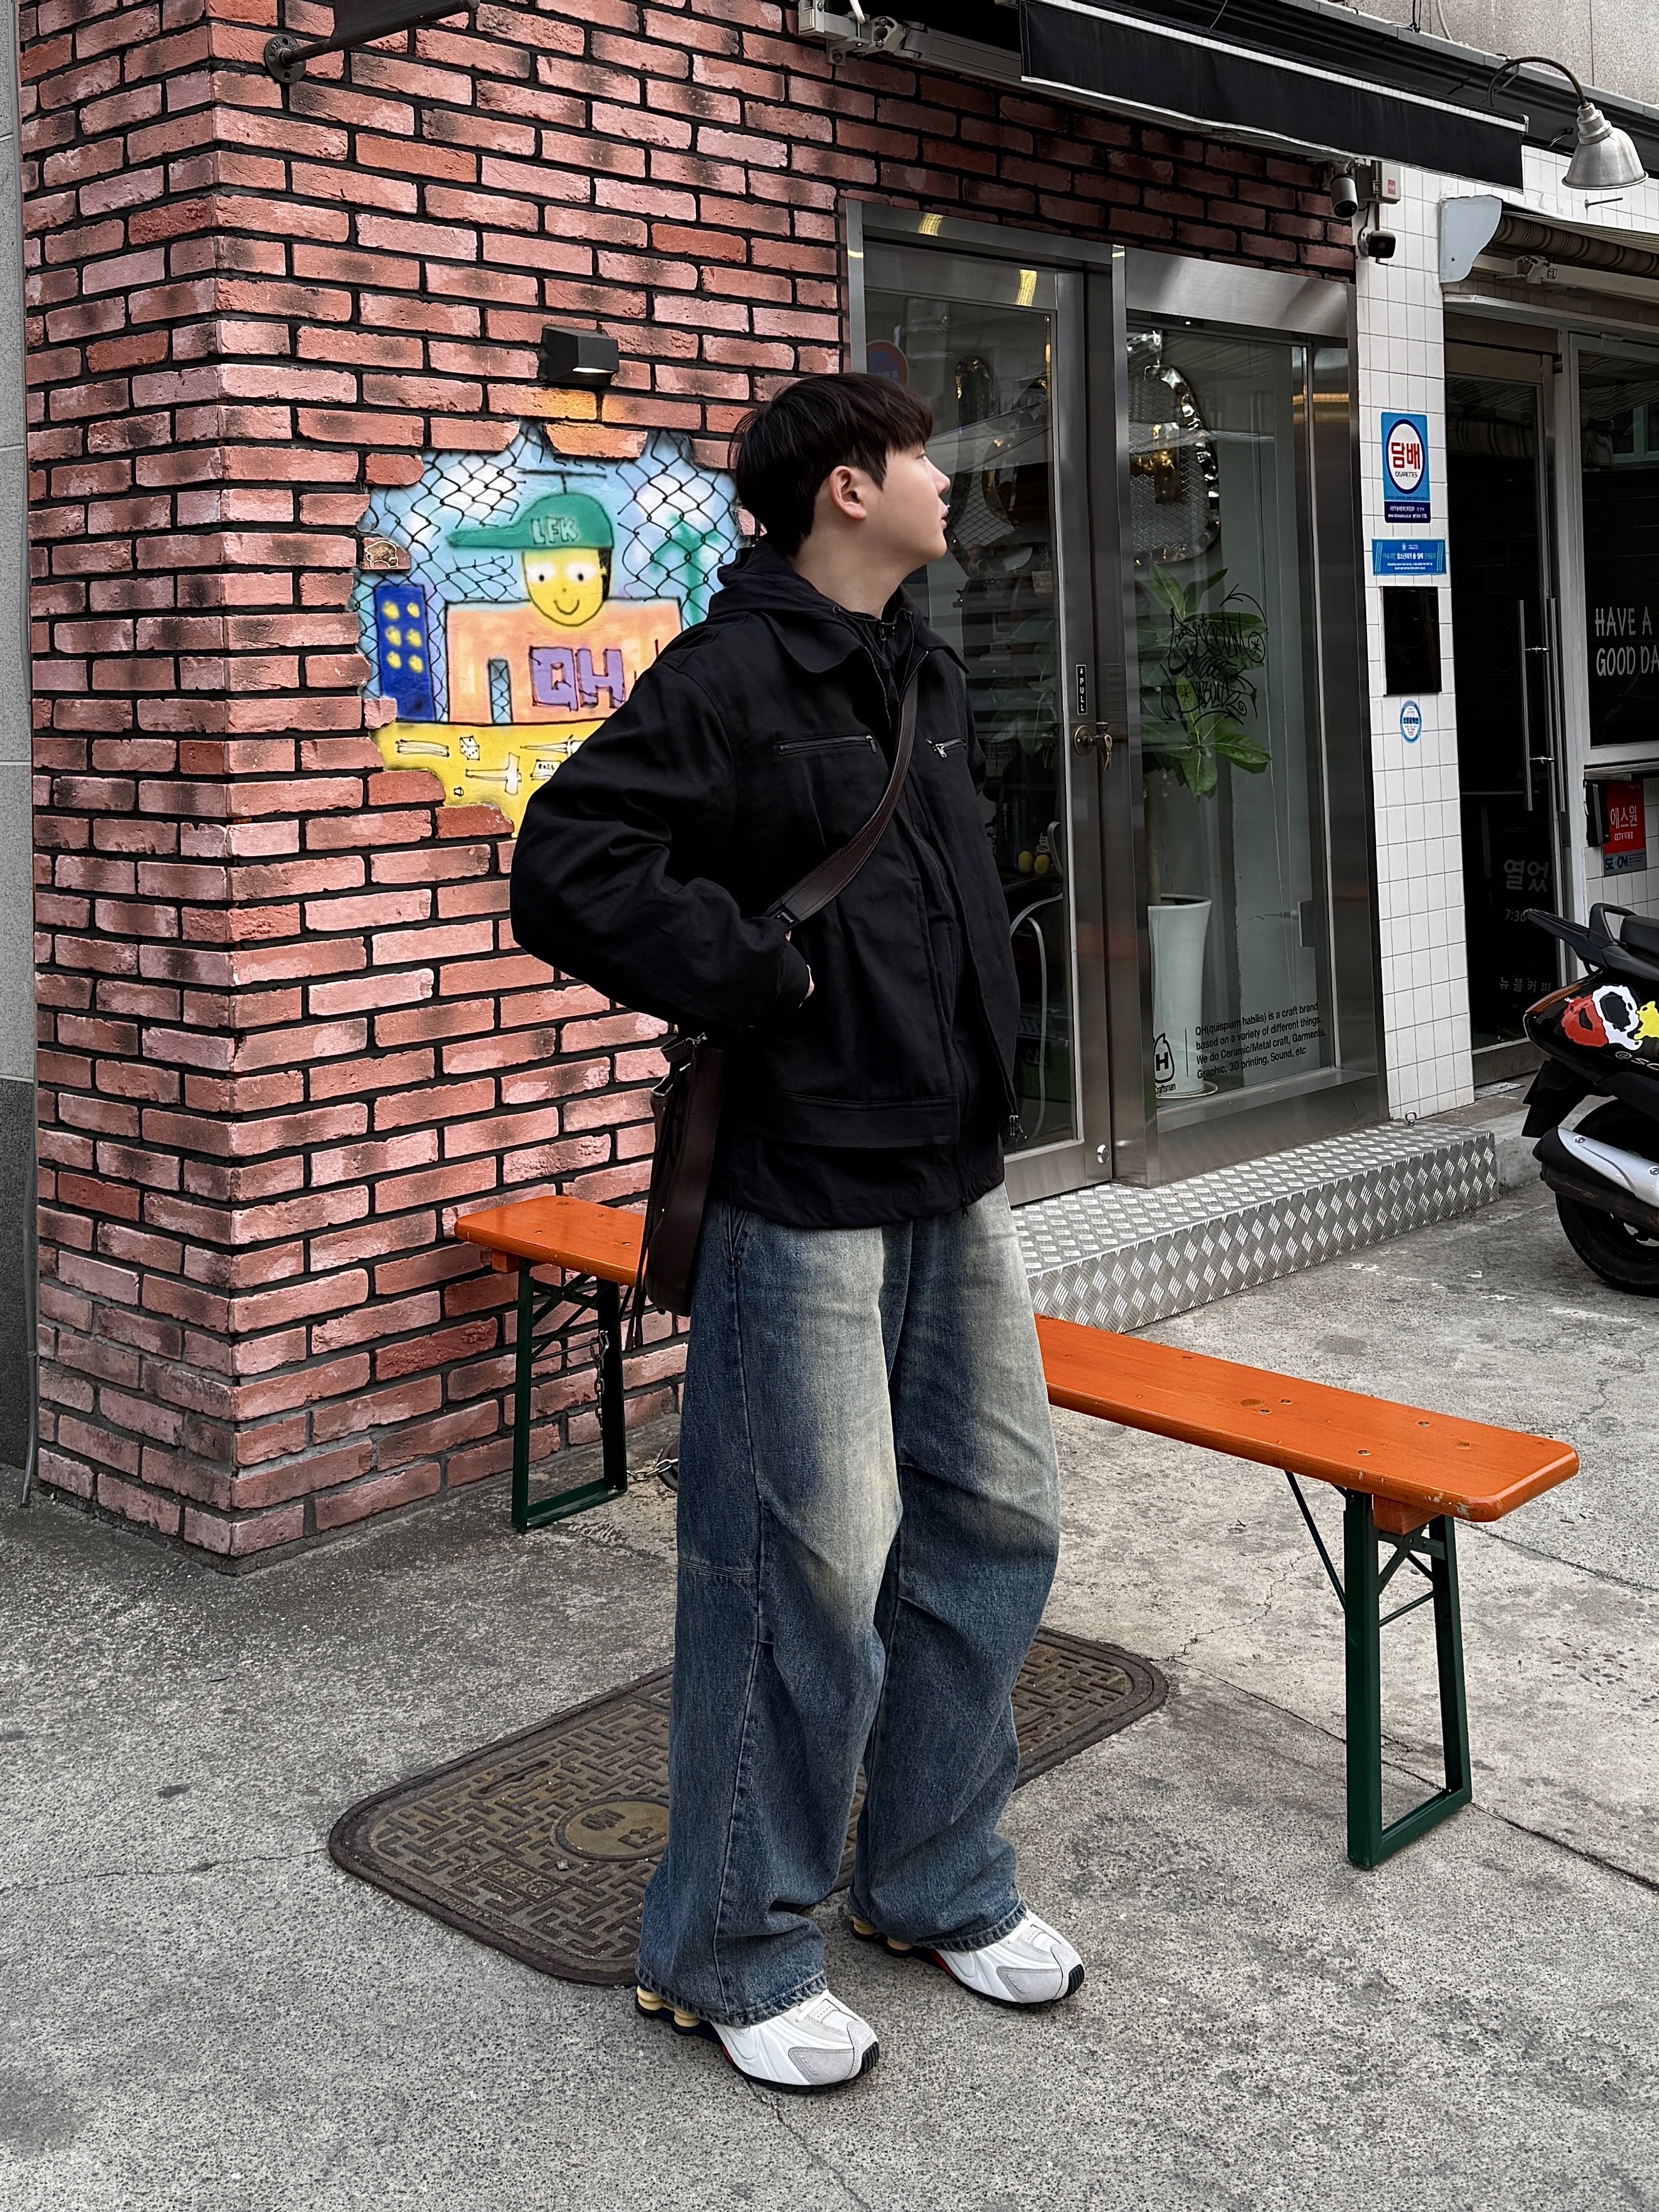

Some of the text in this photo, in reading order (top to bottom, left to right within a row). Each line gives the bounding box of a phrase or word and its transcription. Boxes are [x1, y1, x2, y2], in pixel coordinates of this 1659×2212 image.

[1391, 442, 1420, 470] 담배
[531, 517, 578, 545] LFK
[1595, 606, 1652, 636] HAVE A
[1596, 646, 1636, 676] GOOD
[529, 645, 625, 712] QH
[1610, 805, 1637, 829] 에스원
[1503, 859, 1549, 892] 열었
[1605, 855, 1629, 871] SECOM
[1268, 1012, 1274, 1020] is
[1282, 1006, 1298, 1017] craft
[1299, 1001, 1318, 1014] brand
[1196, 1037, 1219, 1051] based
[1220, 1037, 1229, 1045] on
[1237, 1029, 1260, 1041] variety
[1262, 1026, 1269, 1035] of
[1271, 1019, 1299, 1034] different
[1196, 1054, 1208, 1064] We
[1210, 1052, 1219, 1061] do
[1220, 1040, 1271, 1058] Ceramic/Metal
[1273, 1035, 1291, 1048] craft,
[1197, 1046, 1306, 1079] Graphic, 3D printing, Sound, etc
